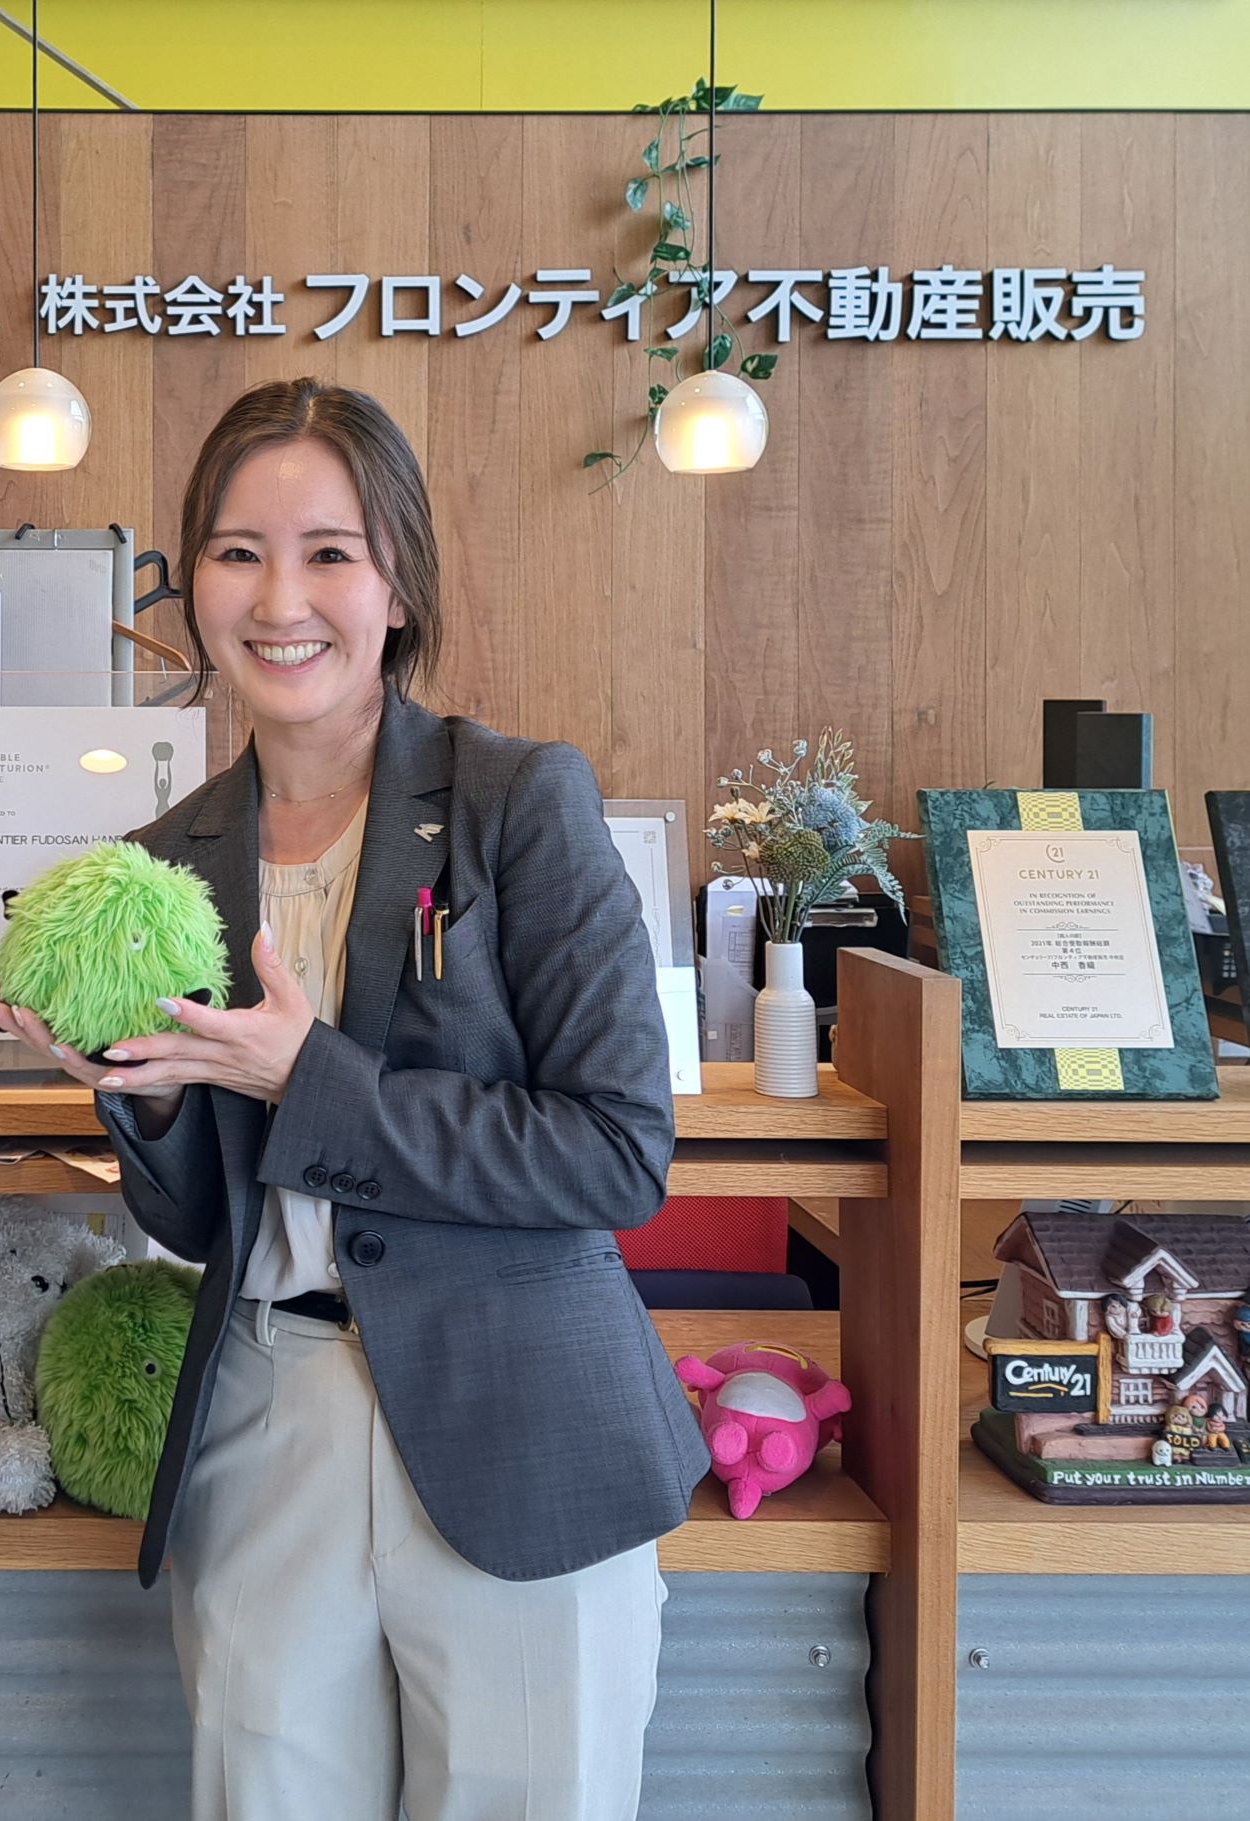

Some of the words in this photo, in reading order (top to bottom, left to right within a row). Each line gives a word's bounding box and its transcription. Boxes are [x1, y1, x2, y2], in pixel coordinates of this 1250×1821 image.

[40, 273, 286, 337] 株式会社
[305, 264, 1147, 343] フロンティア不動産販売
[32, 835, 88, 845] FUDOSAN
[1019, 869, 1083, 880] CENTURY
[1088, 869, 1100, 880] 21
[1005, 1360, 1077, 1385] Century
[1070, 1373, 1091, 1396] 21
[1166, 1433, 1200, 1448] SOLD
[1053, 1471, 1083, 1485] Put
[1085, 1472, 1122, 1487] your
[1126, 1471, 1171, 1485] trust
[1174, 1472, 1193, 1487] in
